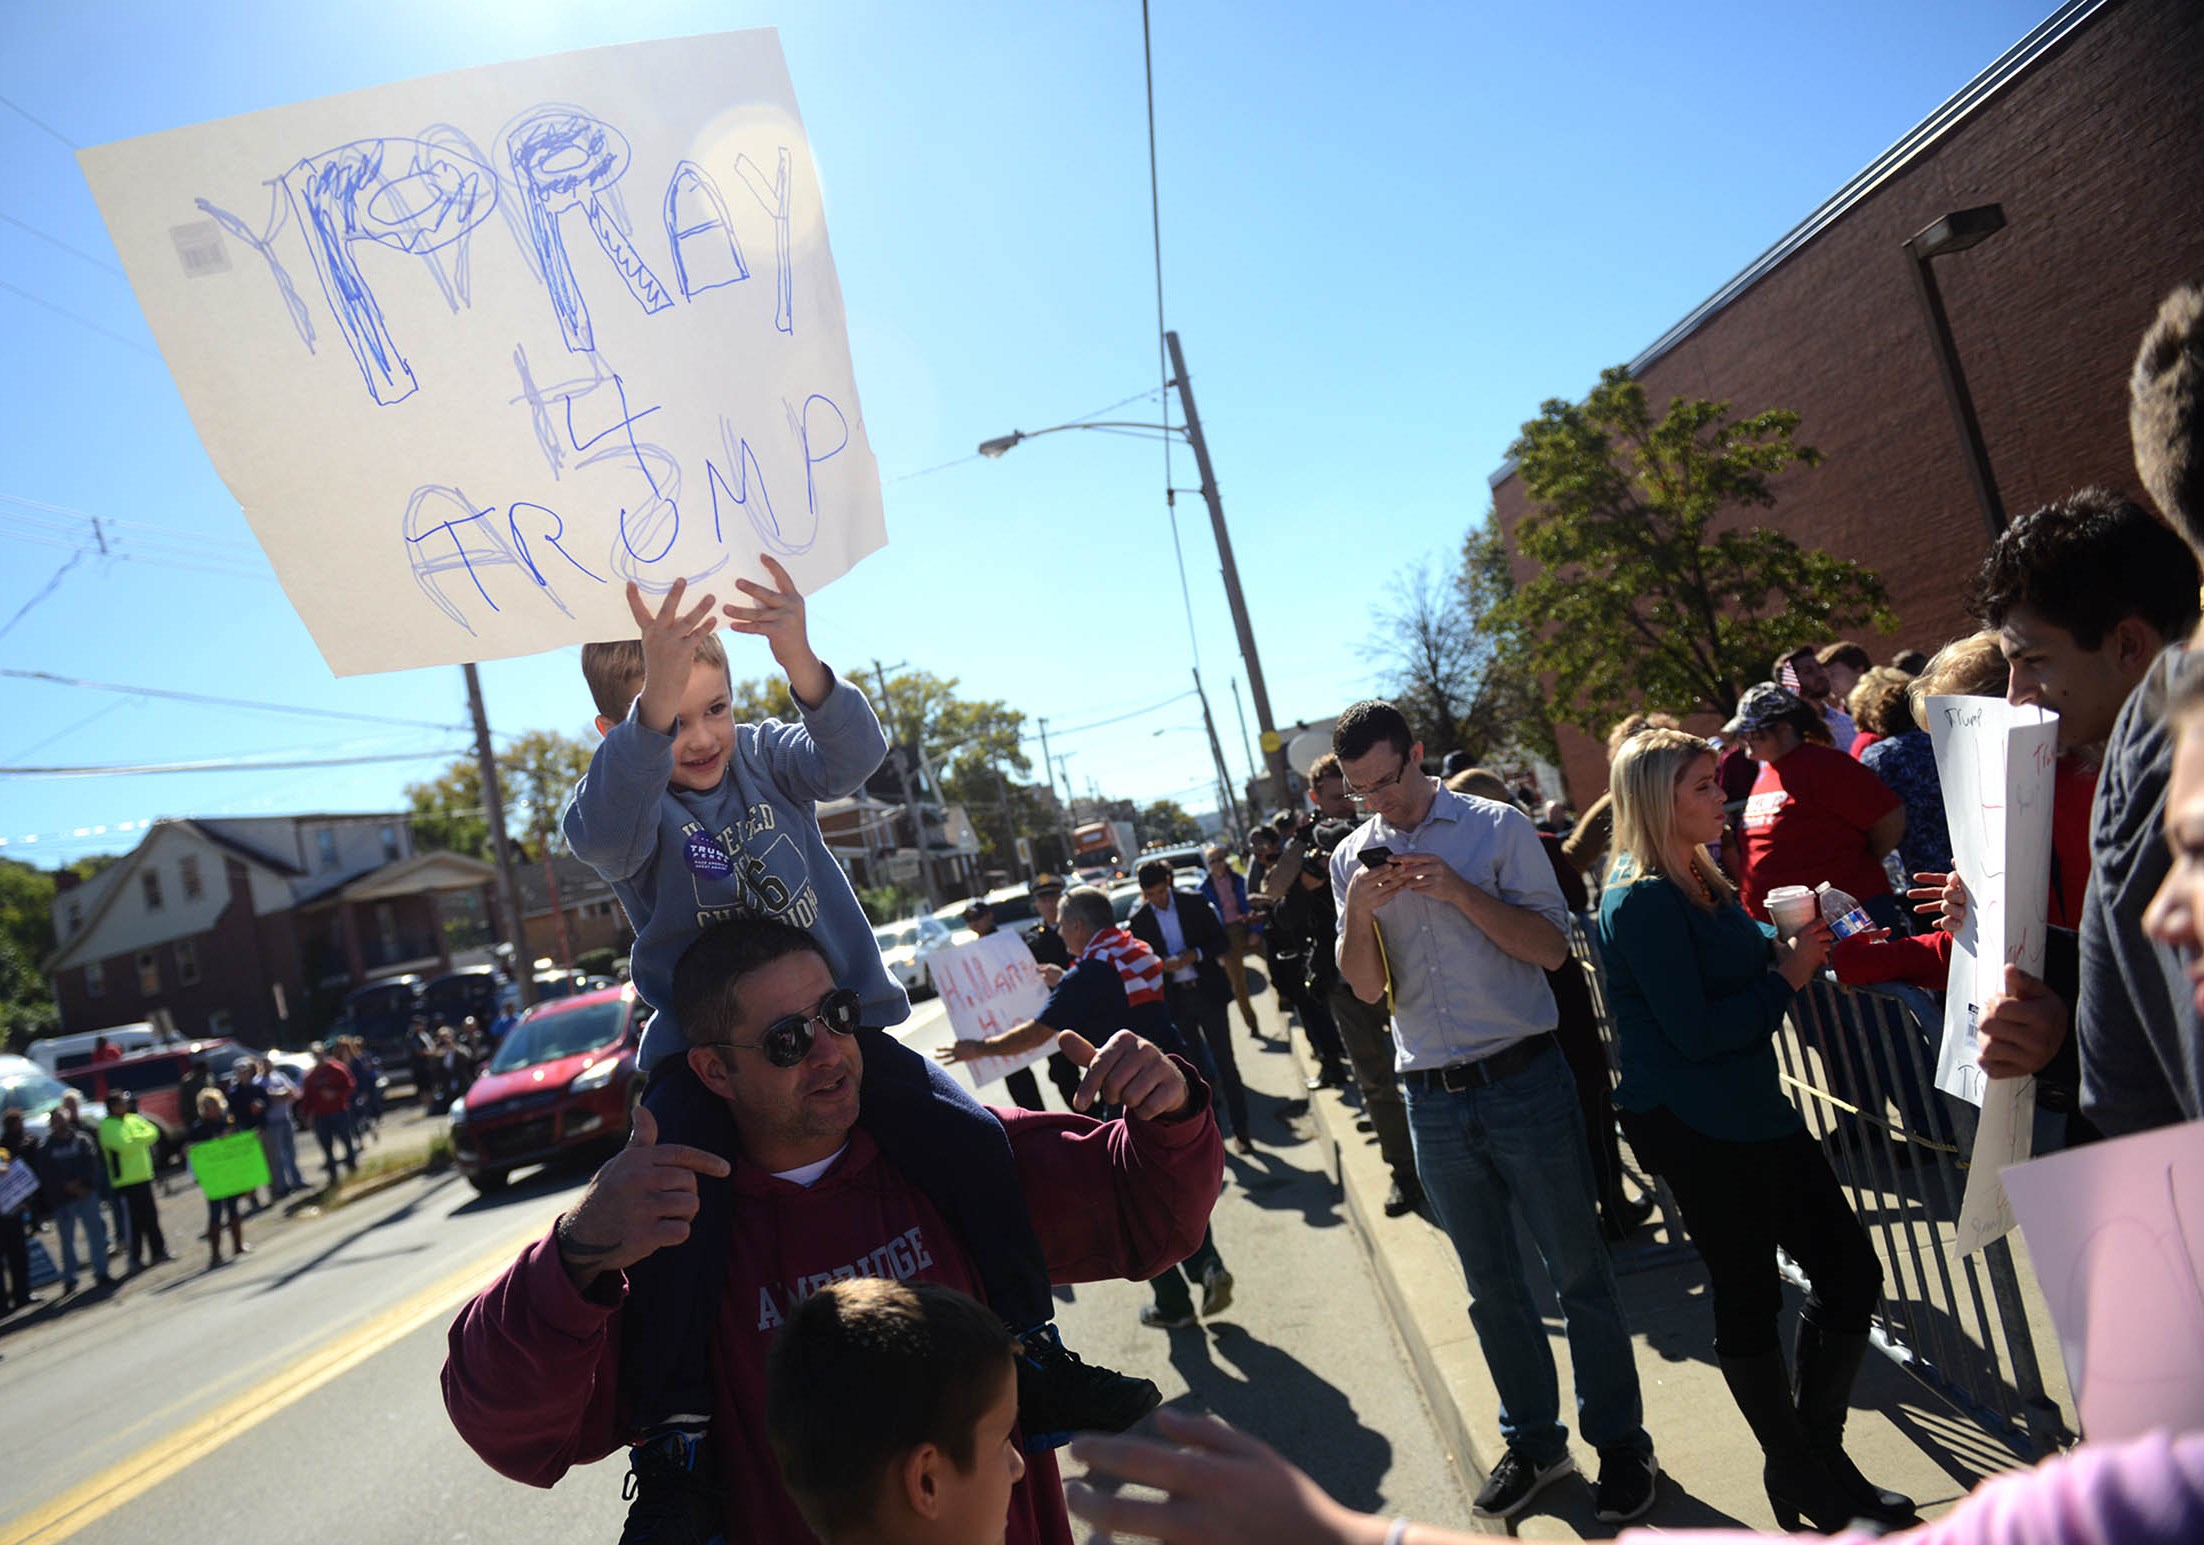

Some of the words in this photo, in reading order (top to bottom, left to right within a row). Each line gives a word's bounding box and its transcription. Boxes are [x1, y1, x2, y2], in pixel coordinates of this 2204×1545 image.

[281, 113, 794, 406] PRAY
[405, 393, 849, 613] TRUMP
[565, 374, 662, 501] 4
